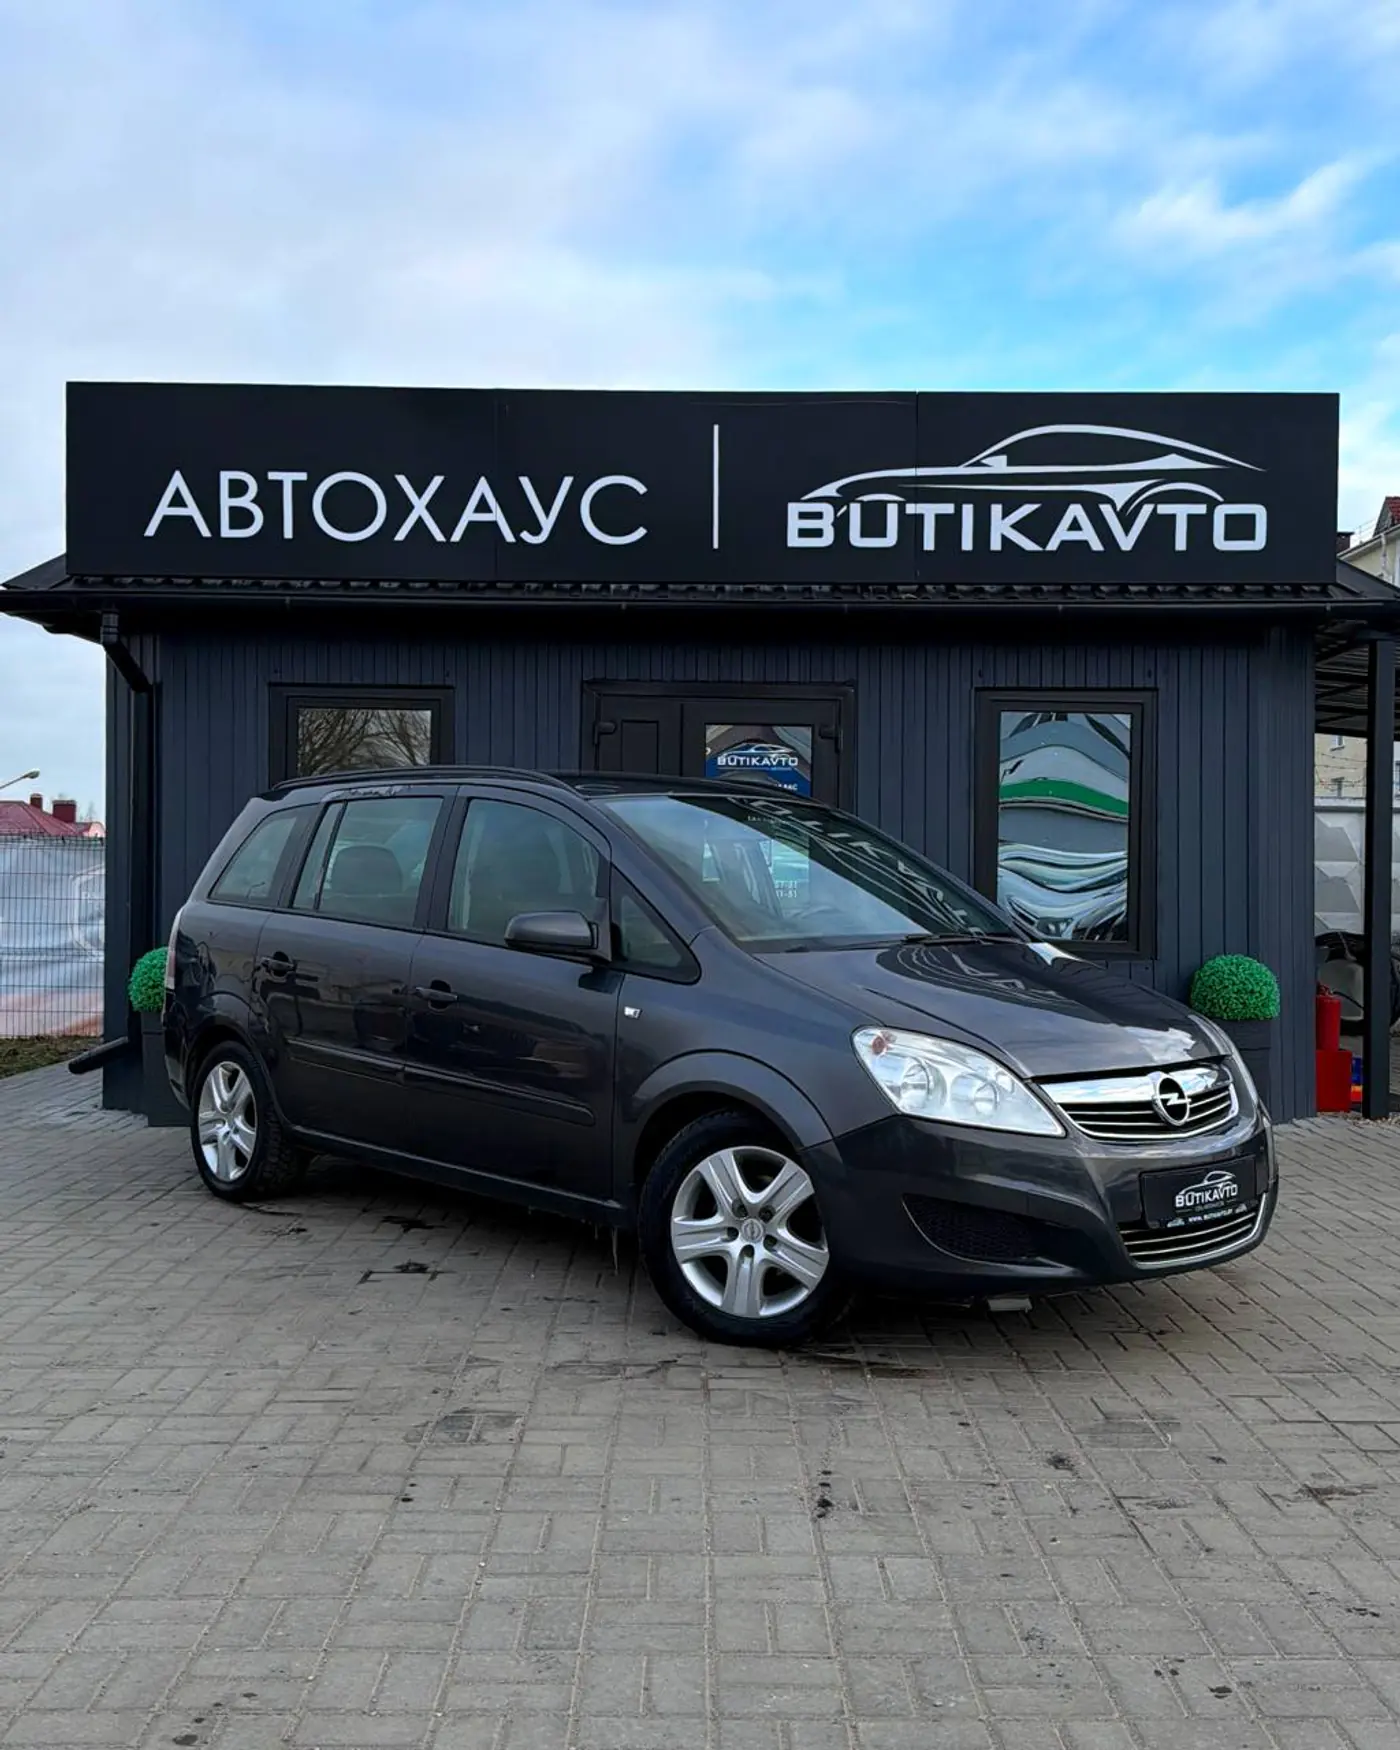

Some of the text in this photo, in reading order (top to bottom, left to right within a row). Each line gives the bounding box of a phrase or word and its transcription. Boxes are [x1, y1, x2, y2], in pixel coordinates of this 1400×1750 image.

[144, 470, 648, 545] АВТОХАУС
[786, 502, 1268, 552] BUTIKAVTO
[717, 756, 798, 766] BUTIKAVTO
[1175, 1184, 1238, 1207] BUTIKAVTO
